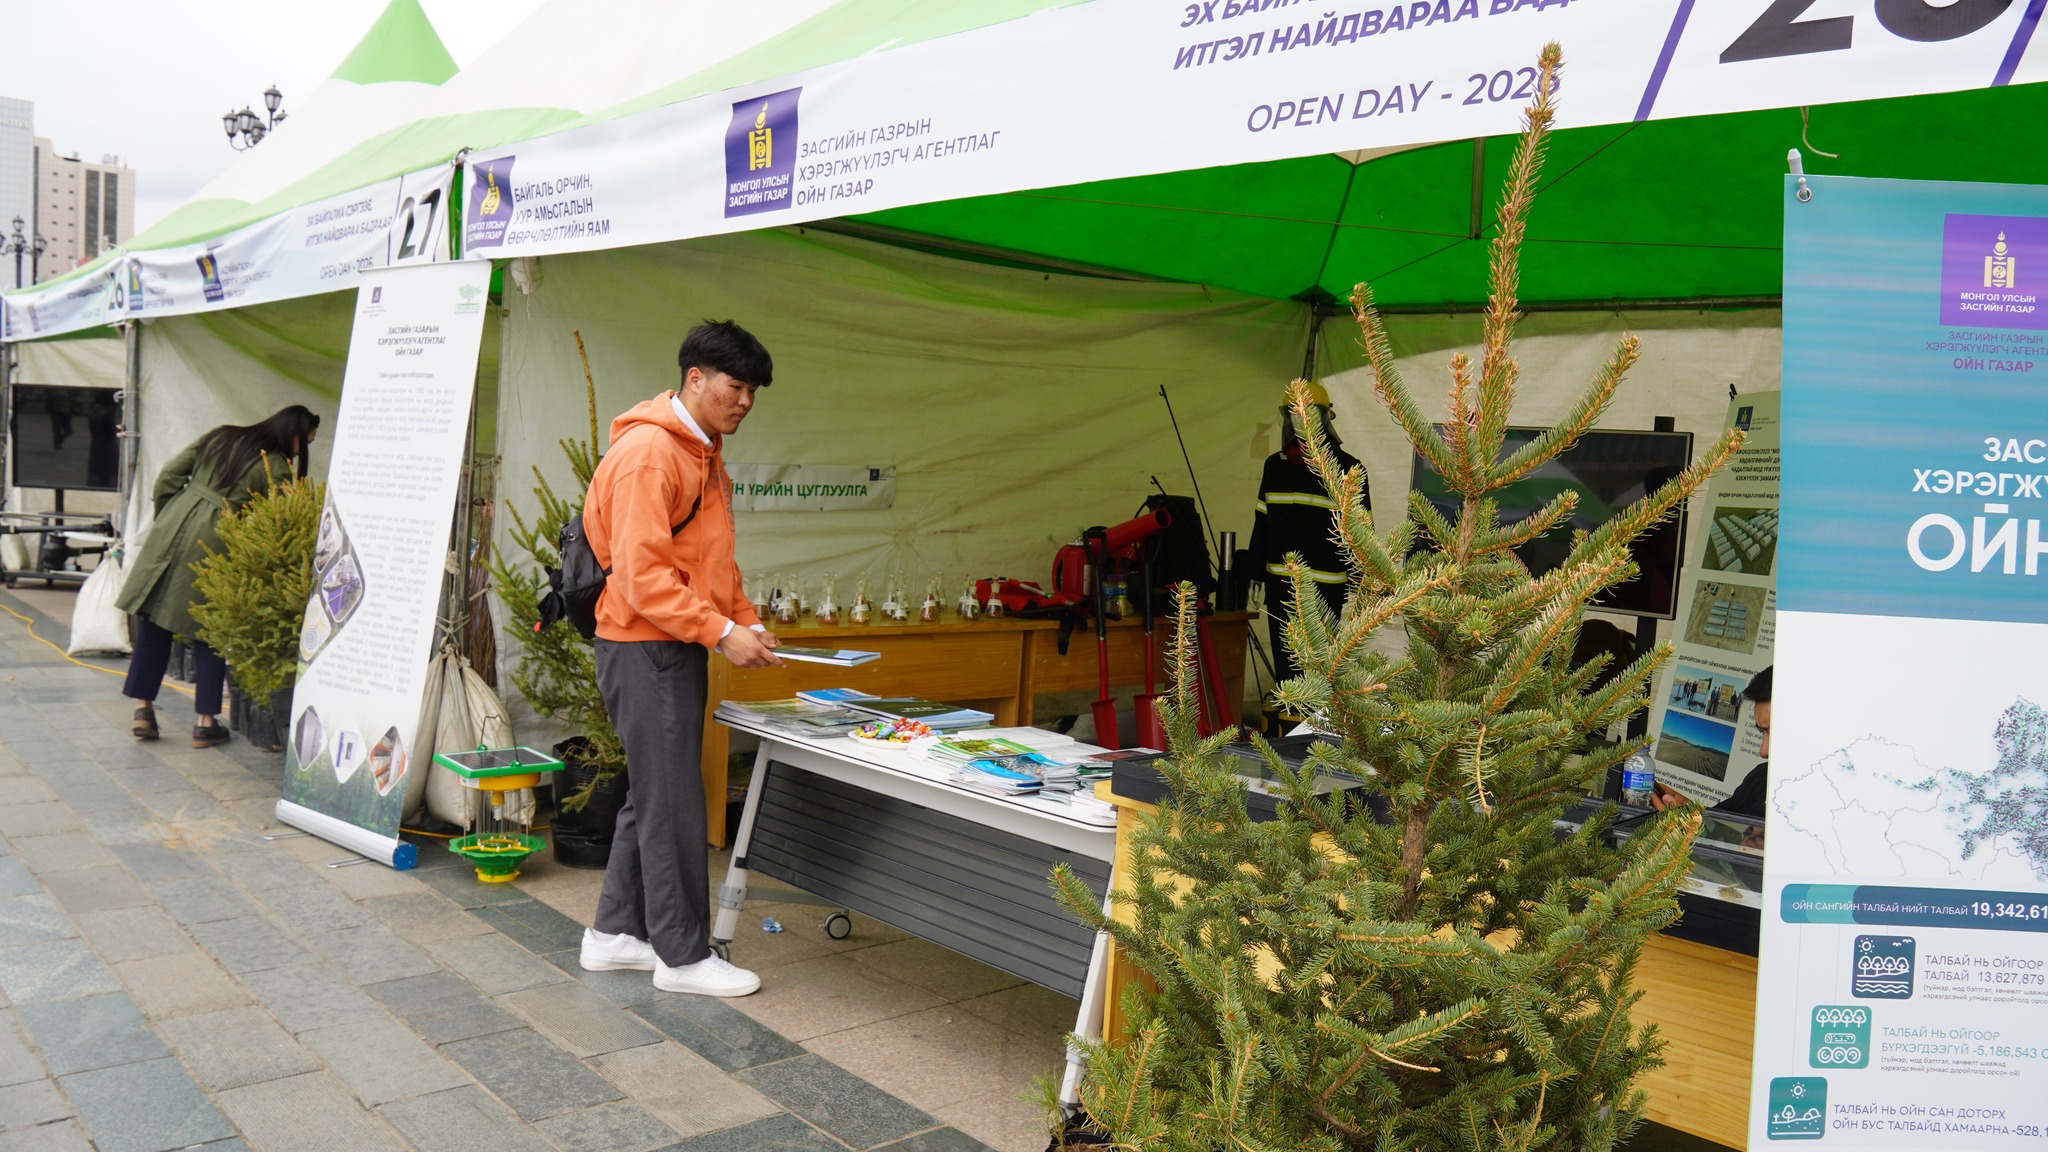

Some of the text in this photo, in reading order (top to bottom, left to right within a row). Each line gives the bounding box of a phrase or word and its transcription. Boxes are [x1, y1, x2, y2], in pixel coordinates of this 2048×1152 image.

[1173, 31, 1265, 70] ИТГЭЛ
[1267, 0, 1479, 54] НАЙДВАРАА
[1247, 93, 1344, 133] OPEN
[1352, 80, 1434, 119] DAY
[801, 117, 931, 158] ЗАСГИЙН ГАЗРЫН
[798, 130, 1000, 182] ХЭРЭГЖҮҮЛЭГЧ АГЕНТЛАГ
[514, 173, 593, 203] БАЙГАЛЬ ОРЧИН,
[730, 173, 789, 194] МОНГОЛ УЛСЫН
[796, 178, 873, 206] ОЙН ГАЗАР
[729, 187, 788, 208] ЗАСГИЙН ГАЗАР
[514, 197, 593, 224] УУР АМЬСГАЛЫН
[397, 188, 442, 260] 27
[507, 219, 610, 245] ӨӨРЧЛӨЛТИЙН ЯАМ
[1960, 292, 2036, 303] МОНГОЛ УЛСЫН
[1960, 301, 2036, 313] ЗАСГИЙН ГАЗАР
[1925, 342, 2010, 354] ХЭРЭГЖҮҮЛЭГЧ
[1948, 331, 2044, 344] ЗАСГИЙН ГАЗРЫН
[1953, 357, 2034, 372] ОЙН ГАЗАР
[1983, 437, 2048, 463] ЗАС
[748, 481, 793, 496] ҮРИЙН
[797, 484, 868, 499] ЦУГЛУУЛГА
[1911, 468, 2048, 498] ХЭРЭГЖ
[1907, 503, 2048, 575] ОЙН
[1792, 900, 1813, 910] ОЙН
[1815, 900, 1860, 911] САНГИЙН
[1862, 901, 1899, 913] ТАЛБАЙ
[1901, 903, 1928, 914] НИЙТ
[1930, 904, 1968, 915] ТАЛБАЙ
[1925, 954, 2044, 970] ТАЛБАЙ НЬ ОЙГООР
[1924, 969, 2045, 985] ТАЛБАЙ 13,627,879
[1883, 1026, 2000, 1041] ТАЛБАЙ НЬ ОЙГООР
[1881, 1042, 1969, 1055] БҮРХЭГДЭЭГҮЙ
[1834, 1103, 2006, 1120] ТАЛБАЙ НЬ ОЙН САН ДОТОРХ
[1832, 1118, 1858, 1130] ОЙН
[1861, 1119, 1884, 1130] БУС
[1887, 1120, 1941, 1133] ТАЛБАЙД
[1944, 1123, 2010, 1135] ХАМААРНА
